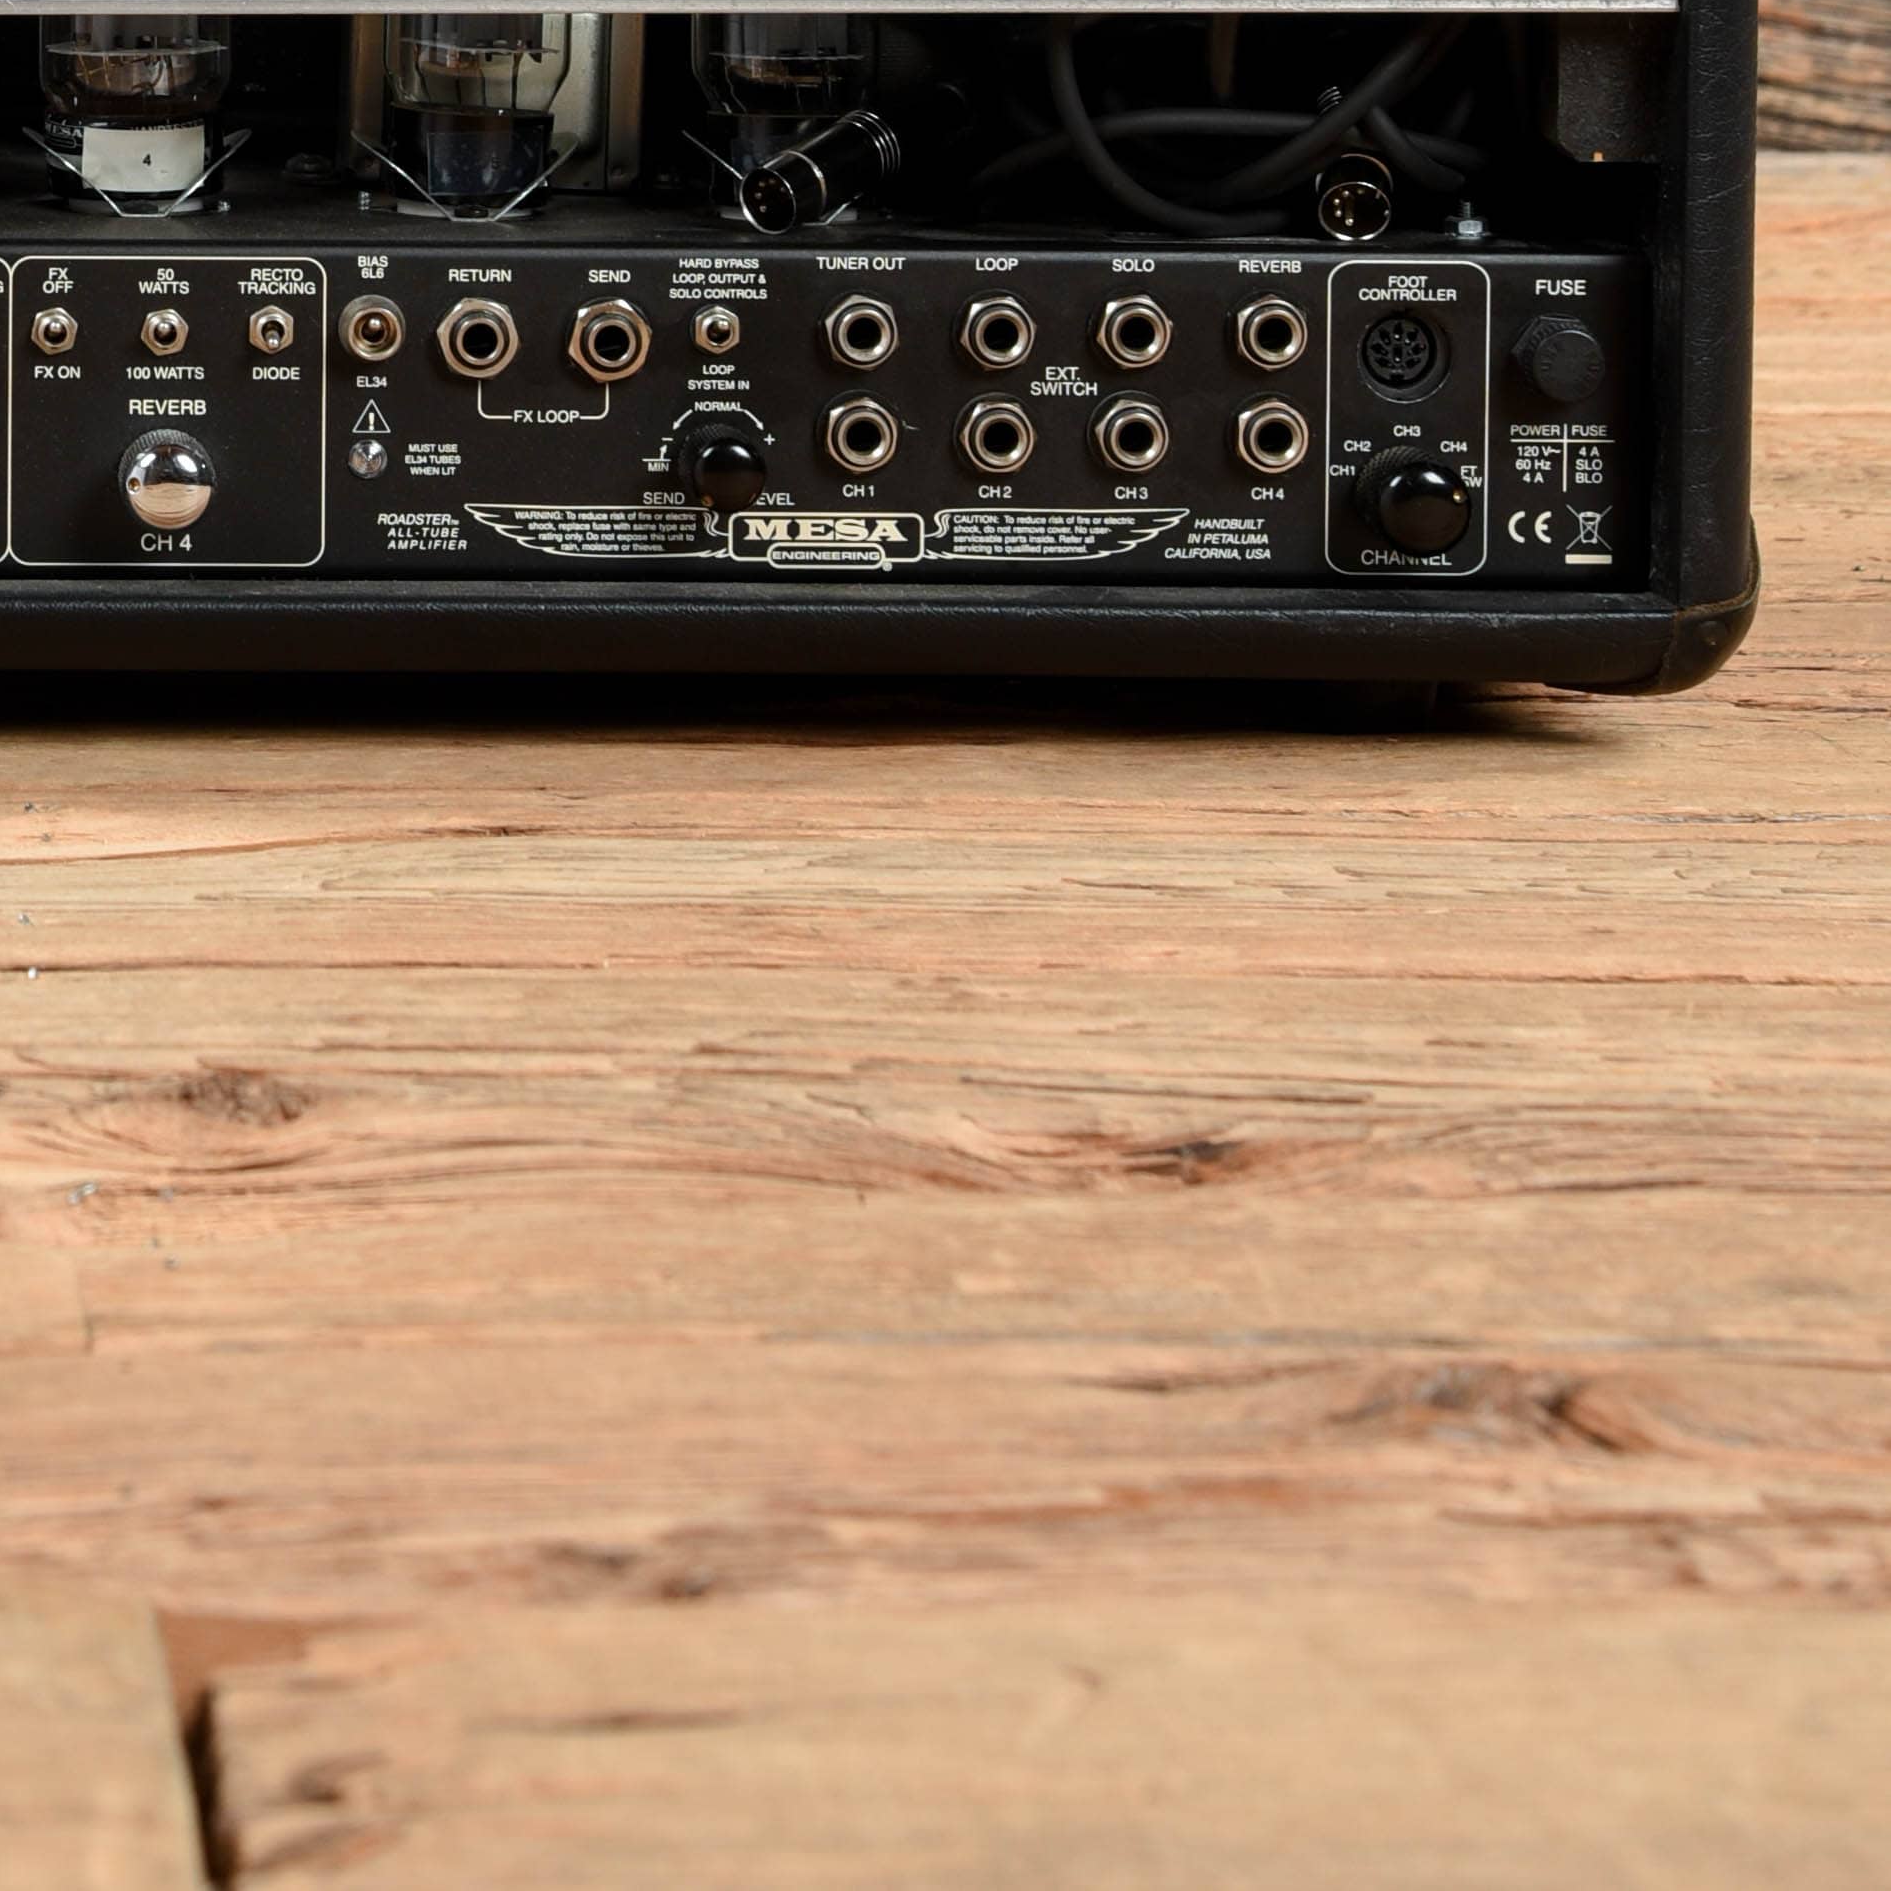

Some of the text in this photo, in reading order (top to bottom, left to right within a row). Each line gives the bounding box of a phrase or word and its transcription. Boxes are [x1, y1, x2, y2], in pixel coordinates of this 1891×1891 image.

[142, 153, 152, 166] 4
[357, 255, 389, 268] BIAS
[678, 257, 760, 270] HARD BYPASS
[815, 255, 907, 271] TUNER OUT
[975, 255, 1019, 272] LOOP
[1111, 256, 1158, 273] SOLO
[1238, 257, 1302, 274] REVERB
[360, 267, 385, 279] 6L6
[448, 268, 512, 283] RETURN
[588, 269, 631, 284] SEND
[672, 272, 767, 286] LOOP, OUTPUT &
[1388, 275, 1429, 289] FOOT
[1535, 279, 1587, 296] FUSE
[668, 287, 768, 300] SOLO CONTROLS
[1358, 288, 1457, 302] CONTROLLER
[252, 366, 301, 381] DIODE
[702, 364, 736, 376] LOOP
[1045, 366, 1081, 381] EXT.
[356, 375, 388, 388] EL34
[687, 379, 750, 391] SYSTEM IN
[1030, 380, 1098, 397] SWITCH
[128, 398, 207, 416] REVERB
[694, 400, 744, 412] NORMAL
[513, 409, 581, 424] FX LOOP
[1393, 424, 1422, 438] CH3
[1510, 424, 1561, 437] POWER
[1571, 424, 1606, 437] FUSE
[408, 443, 458, 454] MUST USE
[1343, 439, 1372, 453] CH2
[1439, 440, 1468, 453] CH4
[1517, 445, 1540, 458] 120
[1578, 445, 1600, 457] 4 A
[404, 454, 462, 465] EL34 TUBES
[1515, 458, 1552, 471] 60 Hz
[1575, 458, 1603, 471] SLO
[409, 466, 457, 476] WHEN LIT
[647, 461, 670, 472] MIN
[1329, 462, 1356, 477] CH1
[1460, 465, 1478, 478] FT
[1522, 471, 1544, 484] 4 A
[1575, 471, 1603, 484] BLO
[842, 483, 875, 498] CH 1
[978, 484, 1013, 499] CH 2
[1114, 486, 1149, 500] CH 3
[1250, 486, 1285, 501] CH 4
[642, 491, 797, 506] SEND EVEL
[743, 518, 909, 542] MESA
[1193, 518, 1266, 530] HANDBUILT
[387, 526, 460, 539] ALL-TUBE
[1187, 532, 1269, 545] IN PETALUMA
[140, 532, 193, 552] CH 4
[387, 539, 468, 551] AMPLIFIER
[771, 550, 880, 562] ENGINEERING
[1164, 547, 1272, 561] CALIFORNIA, USA
